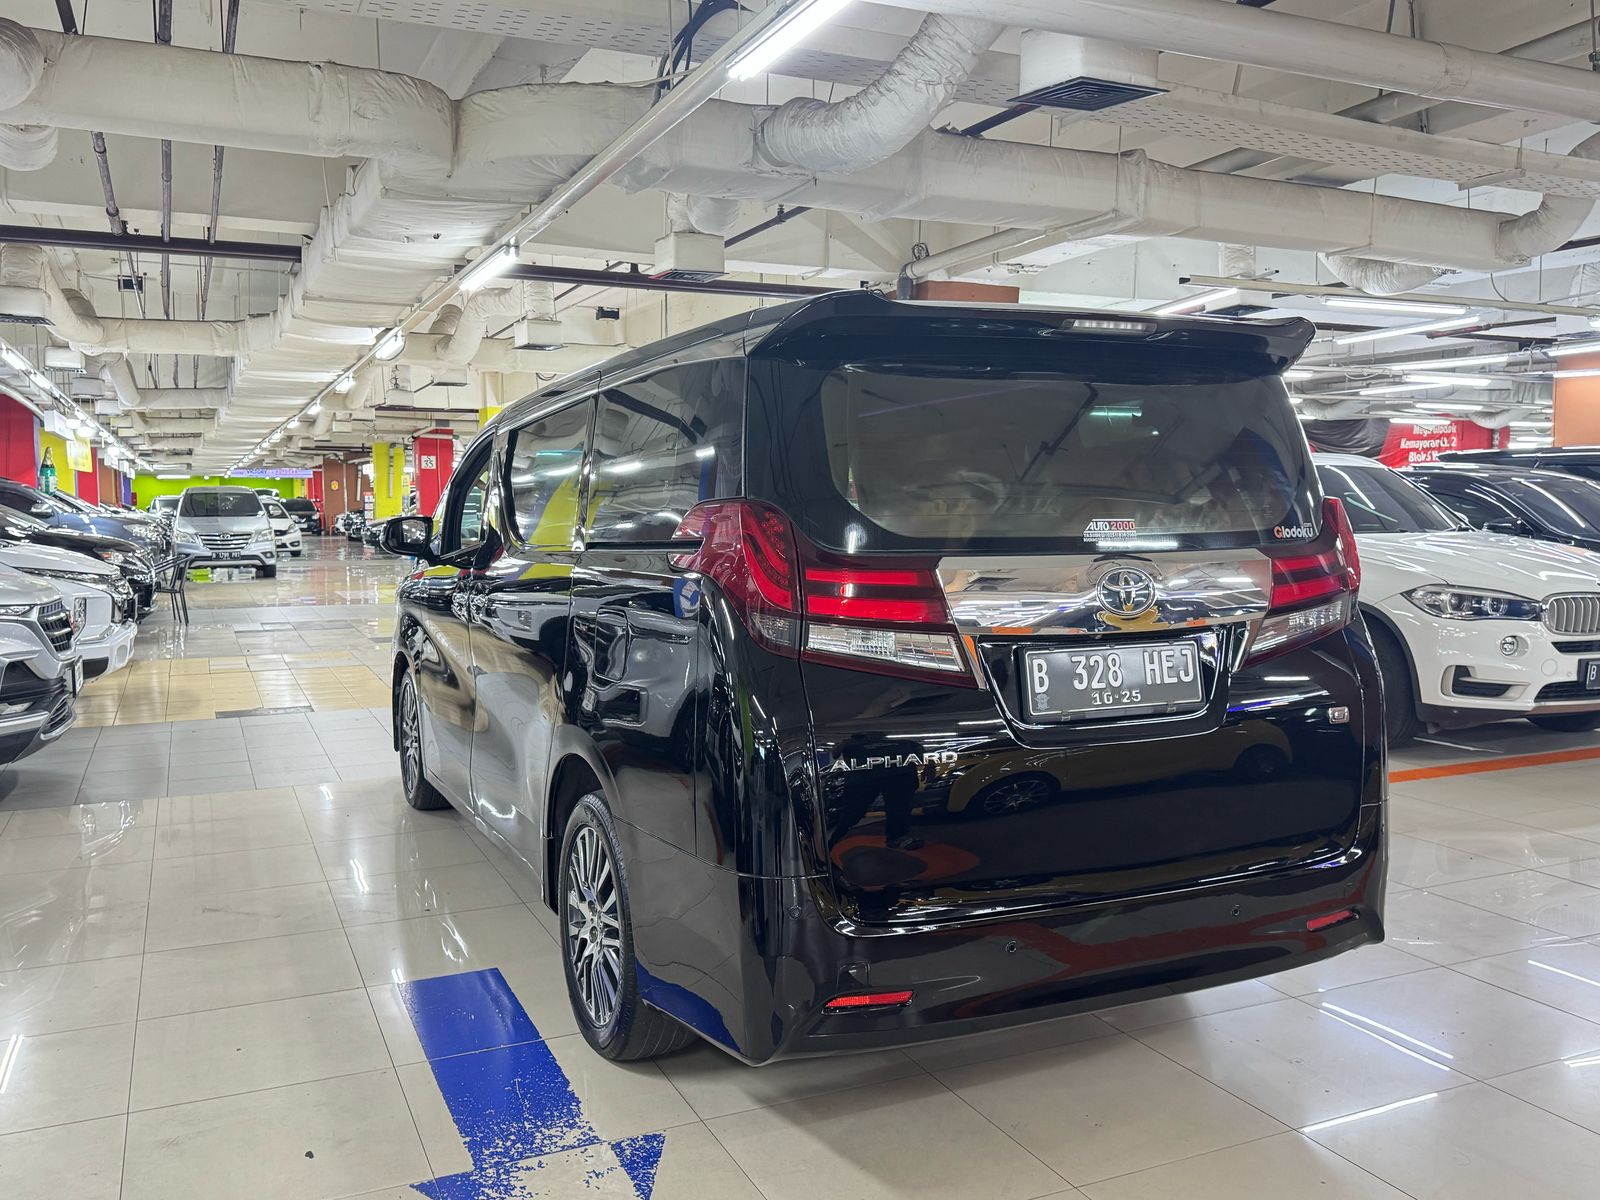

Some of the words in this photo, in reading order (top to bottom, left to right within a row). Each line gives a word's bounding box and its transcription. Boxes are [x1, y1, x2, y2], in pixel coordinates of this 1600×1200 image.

[1451, 437, 1457, 447] 2
[1085, 521, 1110, 531] AUTO
[1110, 521, 1136, 531] 2000
[1032, 658, 1050, 694] B
[1071, 653, 1124, 690] 328
[1143, 649, 1194, 685] HEJ
[1590, 665, 1597, 680] B
[829, 751, 958, 773] ALPHARD
